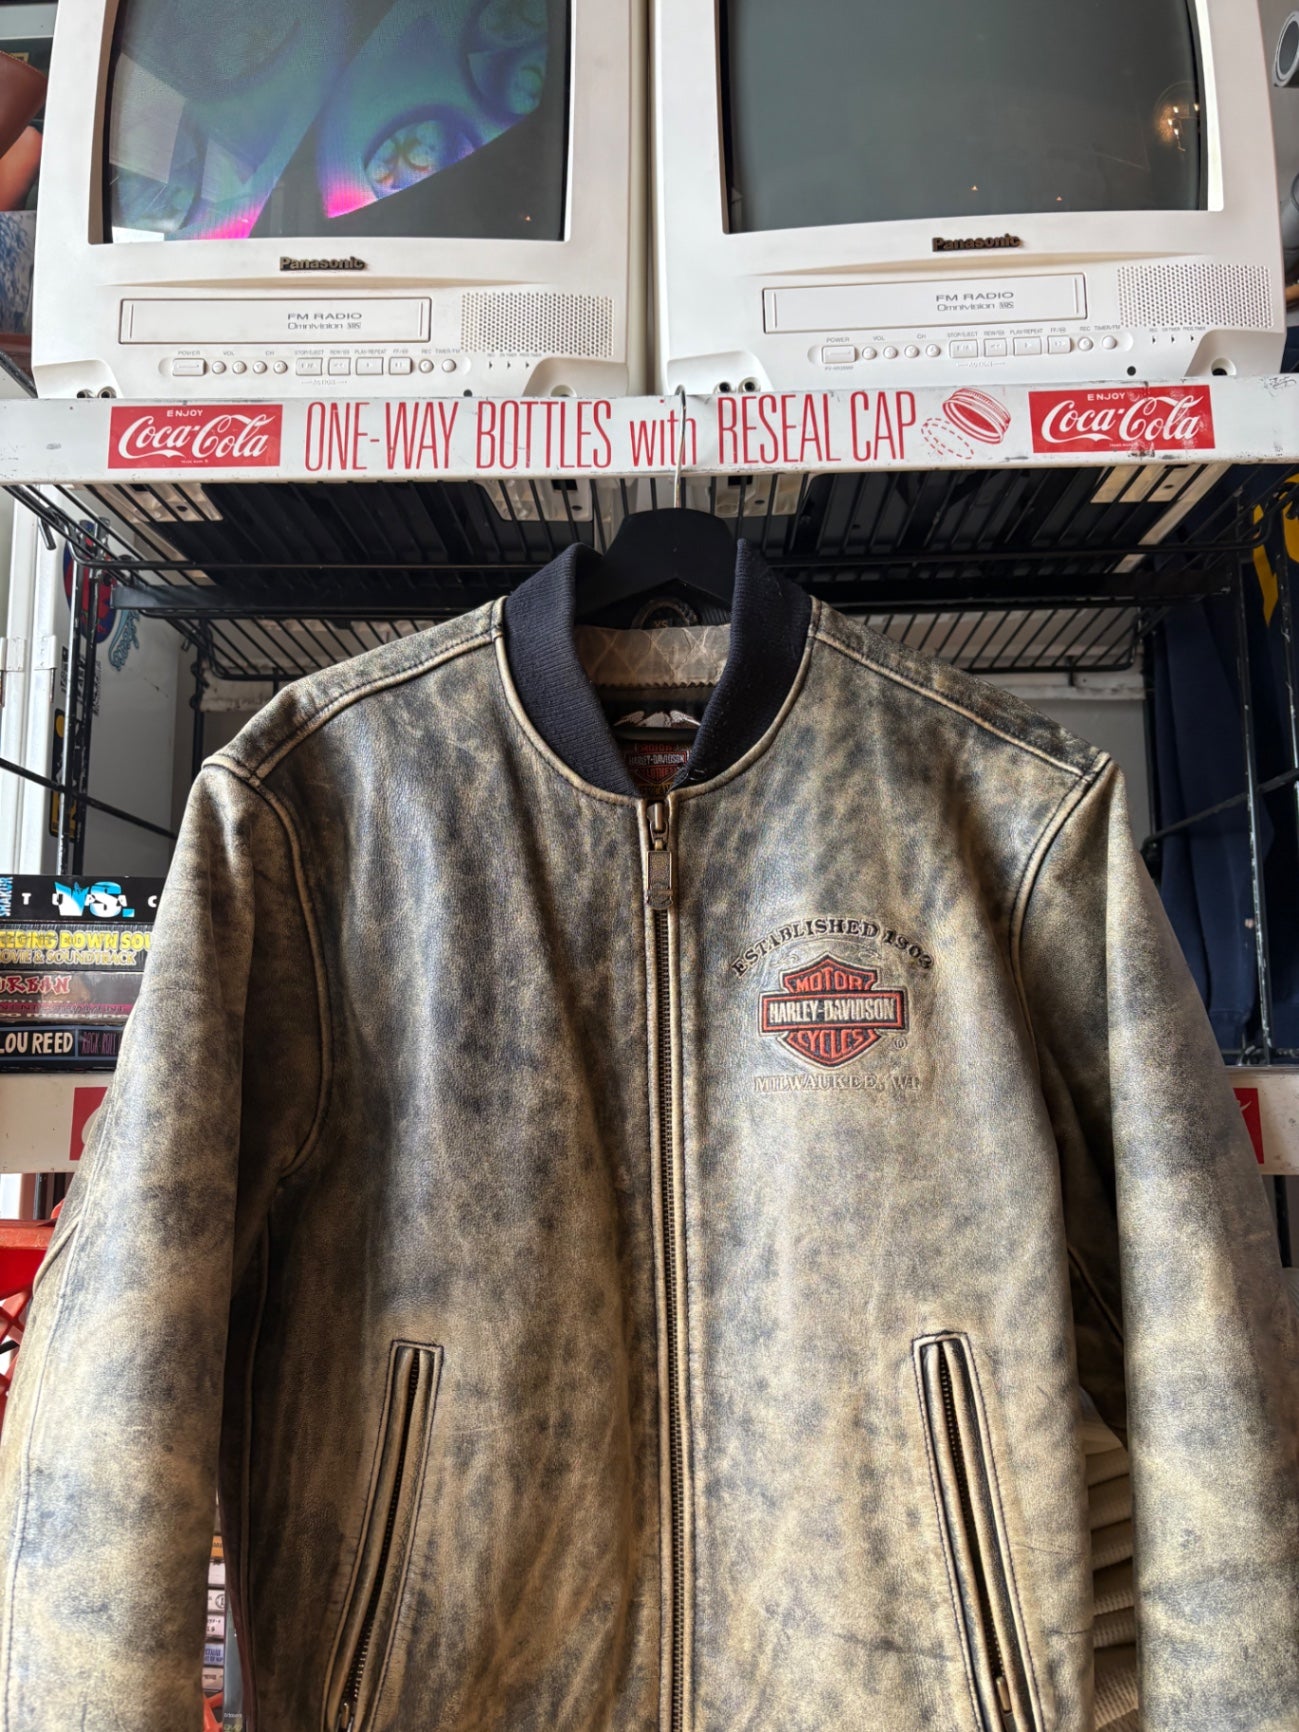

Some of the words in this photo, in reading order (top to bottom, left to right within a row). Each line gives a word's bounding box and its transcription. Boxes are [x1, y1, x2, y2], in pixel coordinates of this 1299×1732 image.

[931, 232, 1023, 252] Panasonic
[279, 255, 366, 272] Panasonic
[936, 294, 958, 302] FM
[963, 291, 1014, 300] RADIO
[287, 313, 309, 321] FM
[313, 312, 362, 320] RADIO
[826, 336, 850, 344] POWER
[872, 334, 885, 342] VOL
[1087, 392, 1125, 401] ENJOY
[166, 409, 203, 417] ENJOY
[1041, 395, 1204, 443] Coca-Cola
[118, 414, 276, 459] Coca-Cola
[305, 401, 459, 471] ONE-WAY
[475, 399, 612, 469] BOTTLES
[629, 399, 697, 467] with
[717, 394, 841, 465] RESEAL
[850, 391, 917, 462] CAP
[59, 930, 119, 951] DOWN
[731, 918, 879, 977] ESTABLISHED
[883, 929, 934, 970] 1903
[46, 949, 136, 966] SOUNDTRACK
[796, 968, 863, 993] MOTOR
[769, 999, 895, 1023] HARLEY-DAVIDSON
[0, 1032, 28, 1054] OU
[32, 1032, 73, 1054] REED
[799, 1030, 867, 1059] CYCLES
